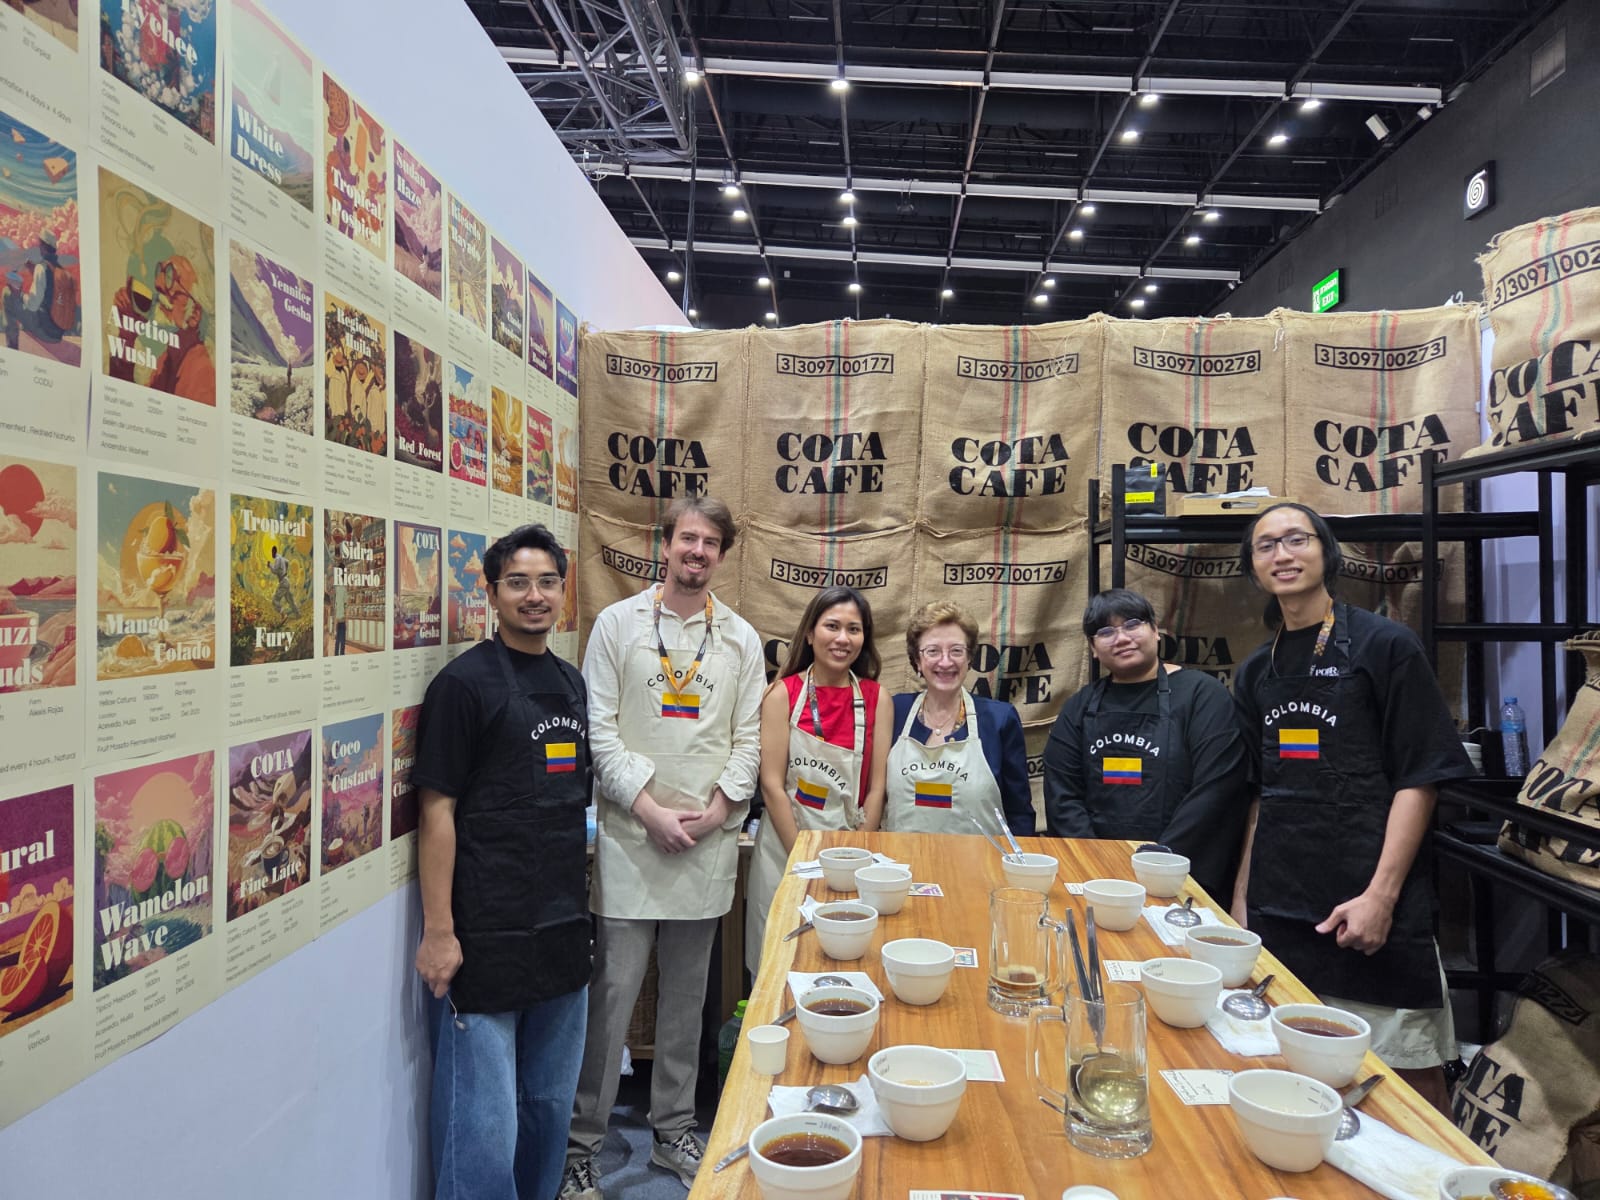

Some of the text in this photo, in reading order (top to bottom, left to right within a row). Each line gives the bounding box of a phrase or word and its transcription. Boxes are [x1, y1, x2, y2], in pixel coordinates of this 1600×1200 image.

[236, 103, 283, 159] White
[237, 133, 282, 185] Dress
[397, 150, 426, 188] Sudan
[1509, 262, 1550, 296] 3097
[1560, 245, 1600, 273] 002
[271, 272, 312, 306] Yennifer
[284, 297, 312, 323] Gesha
[108, 305, 180, 349] Auction
[337, 308, 380, 343] Regional
[107, 335, 158, 370] Wush
[781, 357, 889, 375] 3 3097 00177
[1138, 353, 1256, 373] 3 3097 00278
[1321, 342, 1441, 367] 3 3097 00273
[610, 358, 713, 381] 3 3097 00177
[962, 360, 971, 373] 3
[979, 362, 1018, 378] 3097
[1490, 340, 1600, 408] COT
[1491, 379, 1600, 447] CAF
[399, 435, 442, 461] Red Forest
[608, 432, 711, 469] COTA
[777, 431, 887, 463] COTA
[951, 433, 1070, 466] COTA
[1127, 422, 1257, 459] COTA
[1314, 414, 1451, 458] COTA
[608, 462, 708, 499] CAFE
[775, 464, 884, 495] CAFE
[948, 465, 1067, 498] CAFE
[240, 509, 306, 538] Tropical
[342, 540, 373, 561] Sidra
[416, 532, 440, 550] COTA
[617, 555, 654, 577] 3097
[949, 567, 1063, 581] 3 3097 00176
[1130, 545, 1139, 559] 3
[1146, 552, 1187, 573] 3097
[333, 568, 380, 588] Ricardo
[776, 564, 883, 586] 3 3097 00176
[105, 614, 170, 637] Mango
[419, 610, 440, 622] House
[0, 618, 37, 647] uzi
[255, 627, 295, 651] Fury
[419, 624, 440, 639] Gesha
[973, 642, 1054, 674] OTA
[1157, 635, 1233, 666] OTA
[0, 658, 43, 687] uds
[647, 670, 715, 693] COOBIA
[971, 674, 1051, 705] AFE
[531, 716, 585, 741] COLOMBIA
[1265, 701, 1337, 727] COLOMBIA
[331, 739, 361, 760] Coco
[1090, 733, 1160, 757] COLOMBIA
[250, 748, 295, 778] COTA
[790, 756, 846, 791] COLOMBIA
[901, 760, 969, 783] COLOMBIA
[331, 762, 377, 795] Custard
[0, 829, 55, 873] ural
[240, 859, 302, 900] Fine Latte
[100, 875, 208, 937] Wamelon
[101, 924, 168, 970] Wave
[1463, 1052, 1525, 1122] TA
